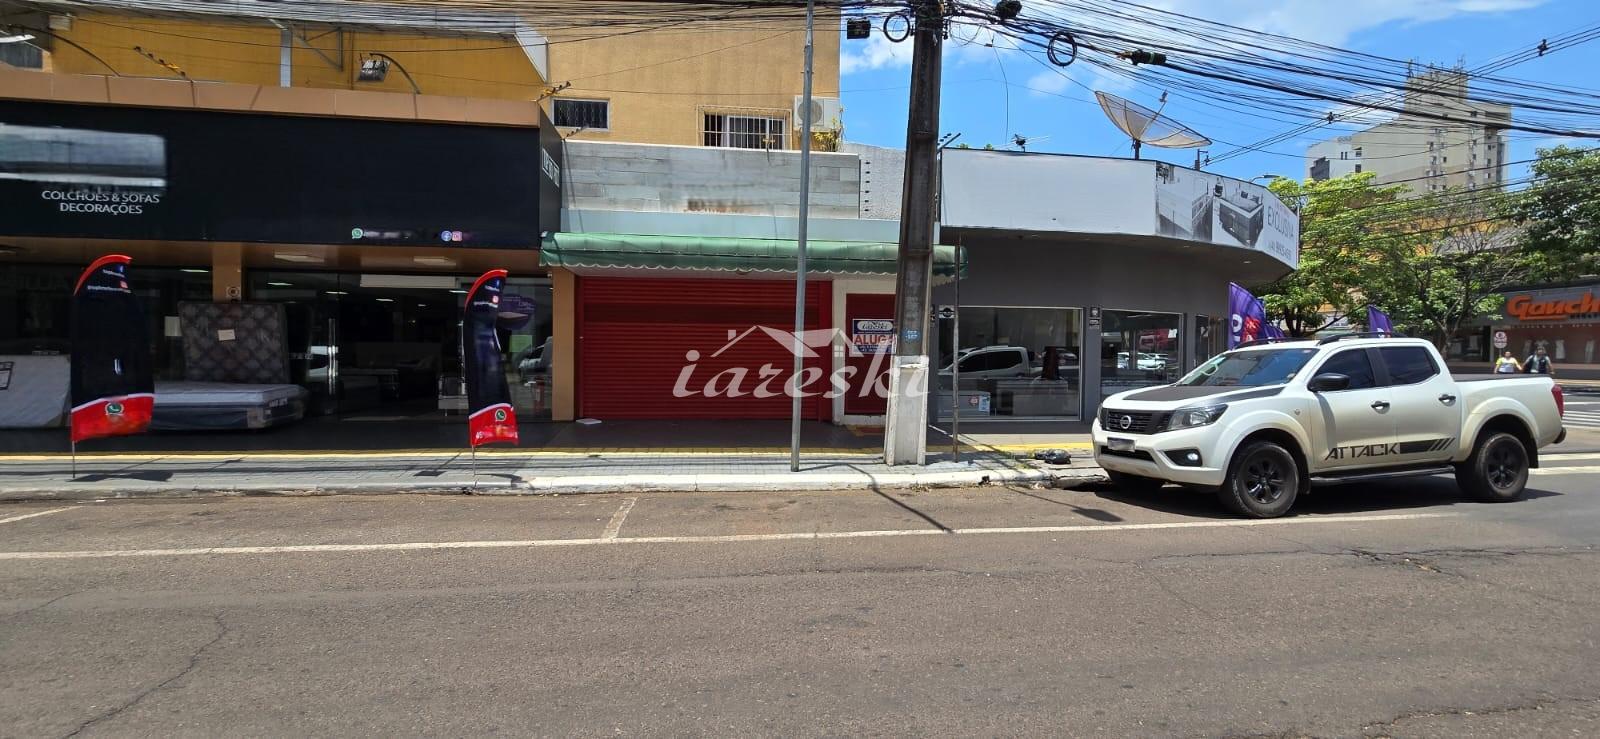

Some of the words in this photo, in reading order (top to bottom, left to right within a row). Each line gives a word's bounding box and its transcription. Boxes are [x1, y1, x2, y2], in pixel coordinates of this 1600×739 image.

[111, 193, 120, 203] &
[60, 202, 143, 215] DECORAÇÕES
[1324, 442, 1398, 461] ATTACK
